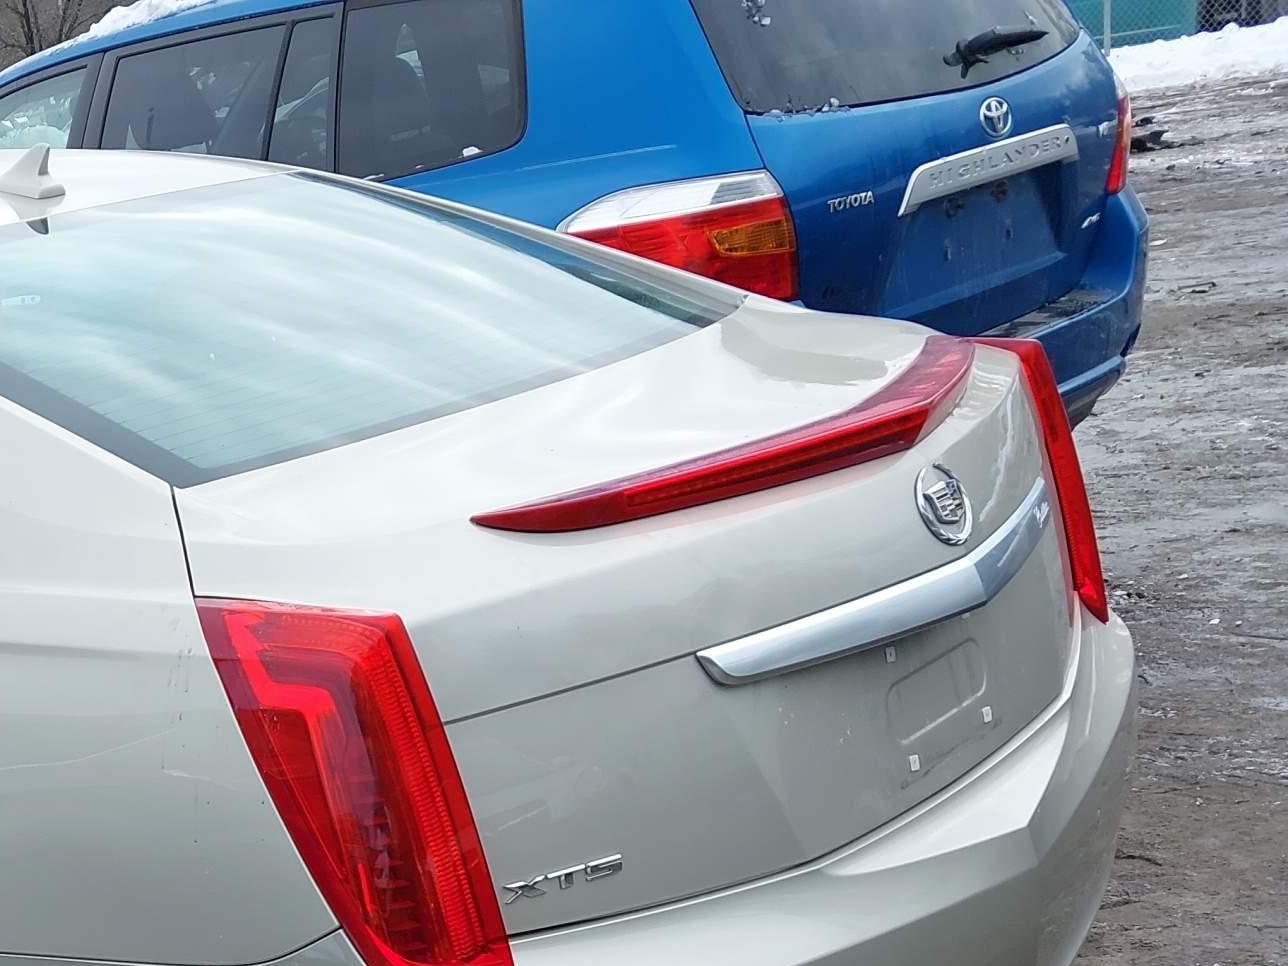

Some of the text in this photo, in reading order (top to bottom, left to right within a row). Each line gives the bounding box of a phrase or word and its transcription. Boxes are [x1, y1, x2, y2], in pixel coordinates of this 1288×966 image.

[928, 136, 1062, 189] HIGHLANDER
[827, 190, 874, 213] TOYOTA
[502, 853, 623, 904] XTS
